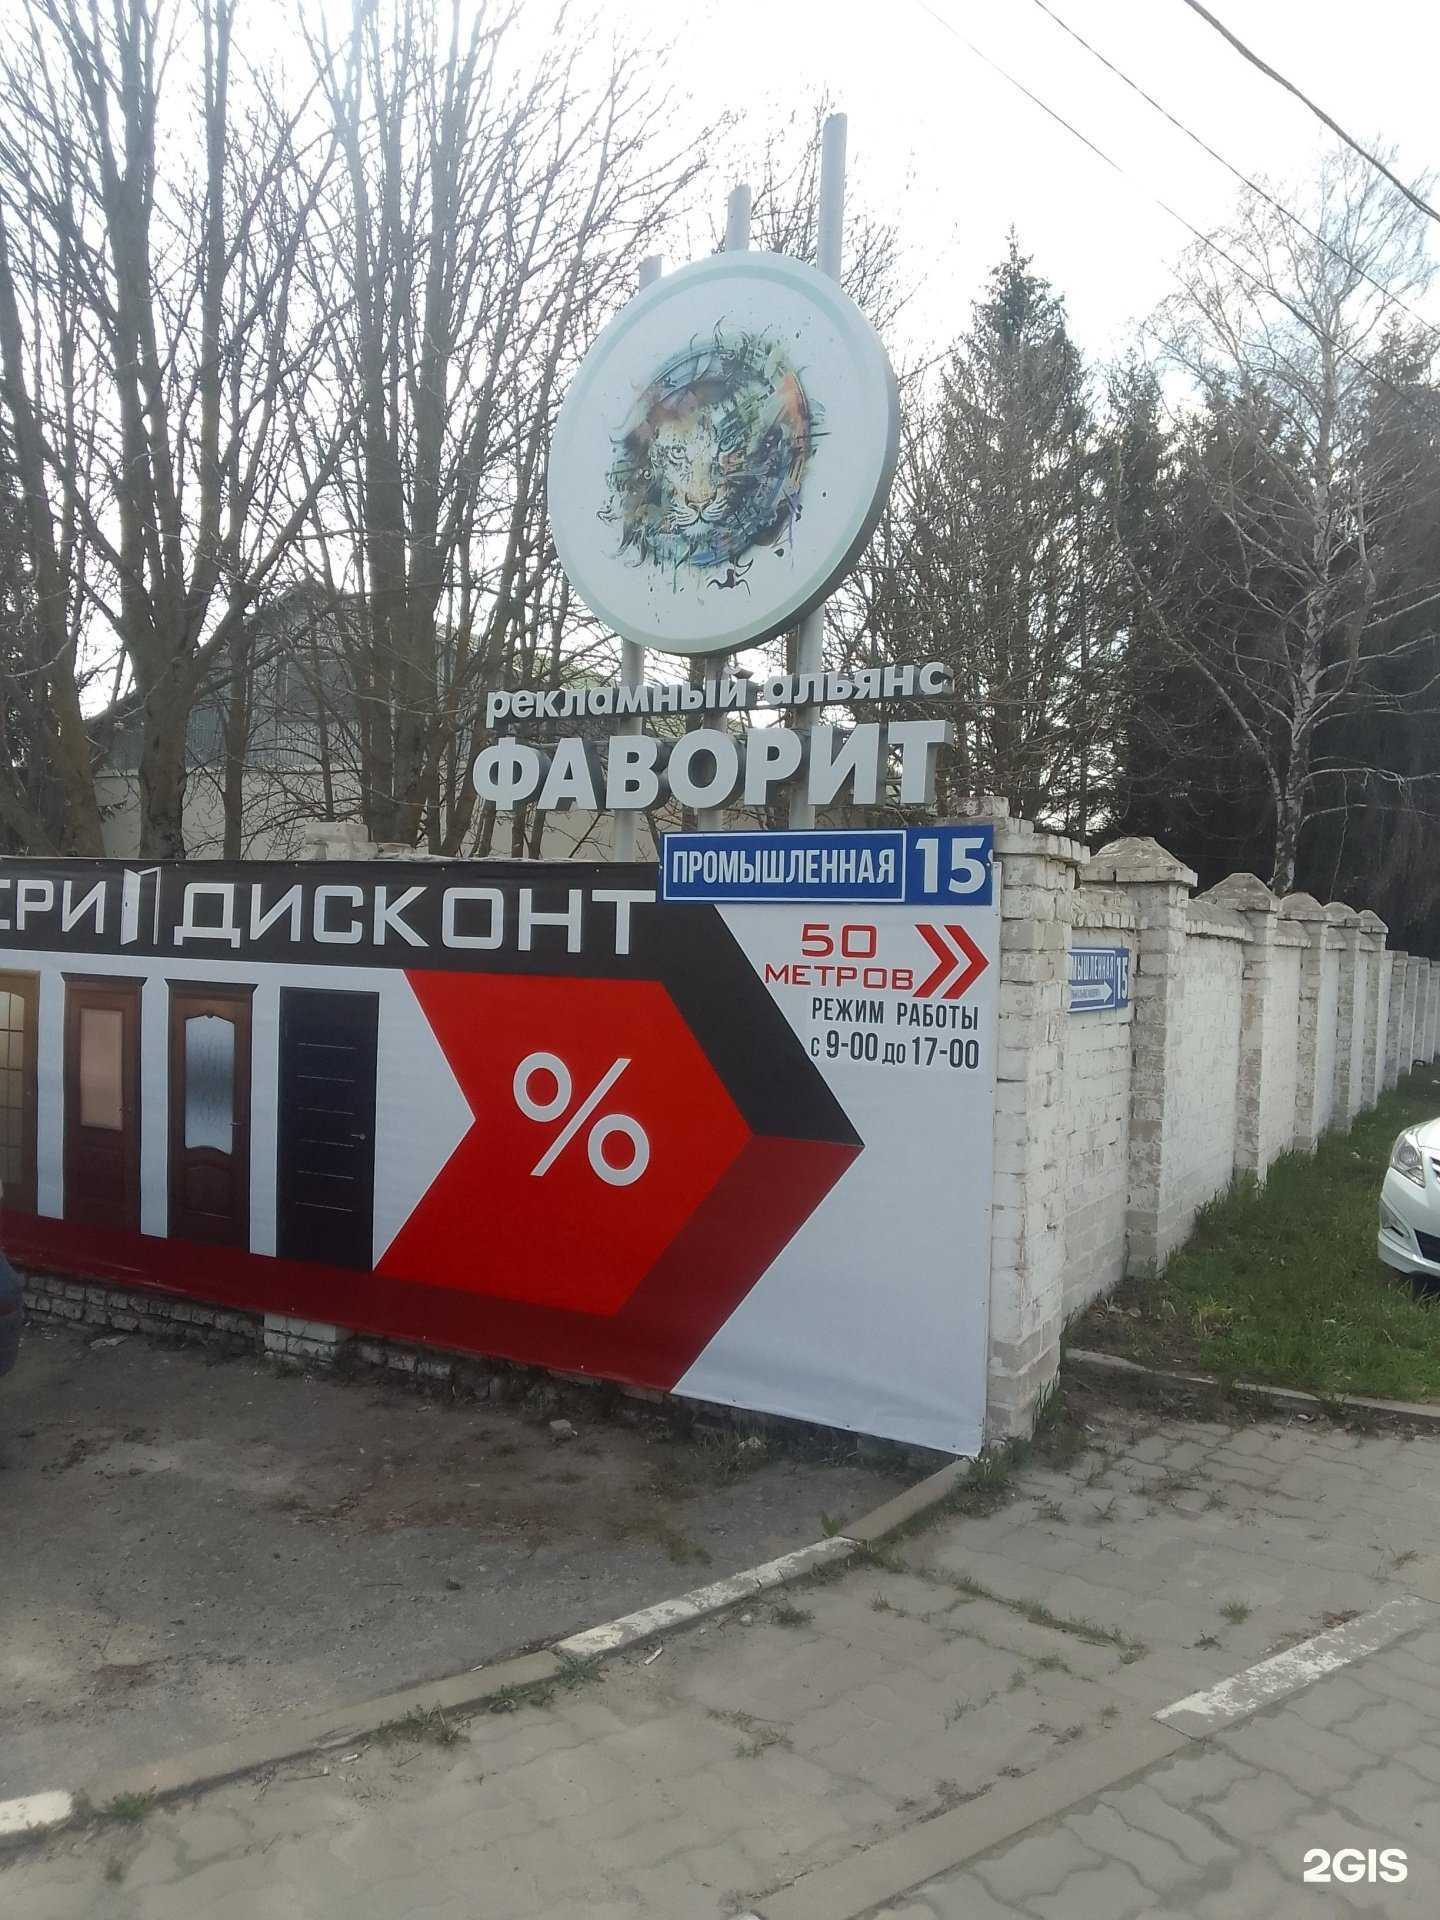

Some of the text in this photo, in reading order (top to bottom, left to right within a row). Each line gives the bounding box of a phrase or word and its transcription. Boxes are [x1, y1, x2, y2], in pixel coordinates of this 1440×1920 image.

[486, 662, 953, 728] рекламный альянс
[473, 720, 953, 811] ФАВОРИТ
[671, 837, 986, 894] ПРОМЫШЛЕННАЯ 15
[173, 882, 657, 955] ДИСКОНТ
[801, 923, 878, 959] 50
[765, 963, 914, 990] МЕТРОВ
[1116, 957, 1128, 999] 15
[812, 997, 979, 1030] РЕЖИМ РАБОТЫ
[826, 1029, 879, 1061] 9-00
[882, 1042, 906, 1065] до
[912, 1036, 980, 1069] 17-00
[513, 1052, 650, 1187] %
